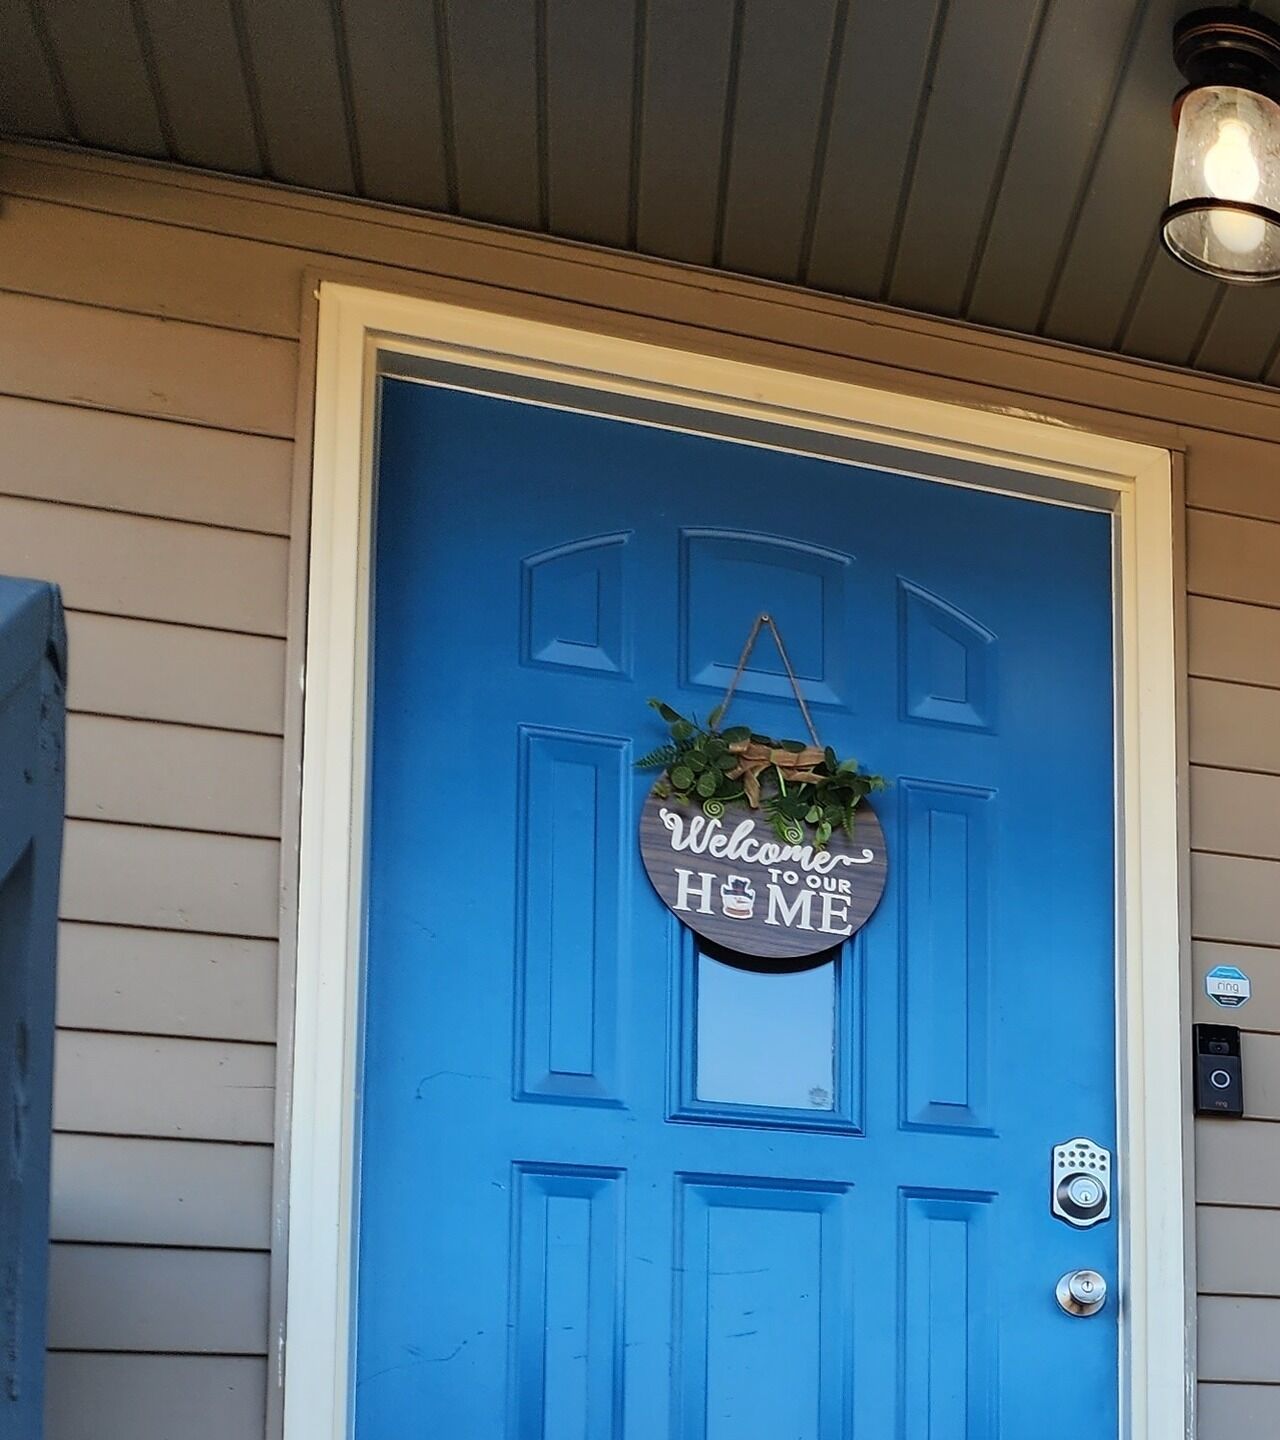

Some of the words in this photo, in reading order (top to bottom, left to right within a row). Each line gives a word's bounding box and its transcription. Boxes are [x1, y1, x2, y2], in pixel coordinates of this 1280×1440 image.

[659, 808, 873, 874] Welcome
[672, 868, 853, 936] HME
[768, 868, 799, 885] TO
[806, 875, 852, 894] OUR
[1217, 981, 1239, 993] ring
